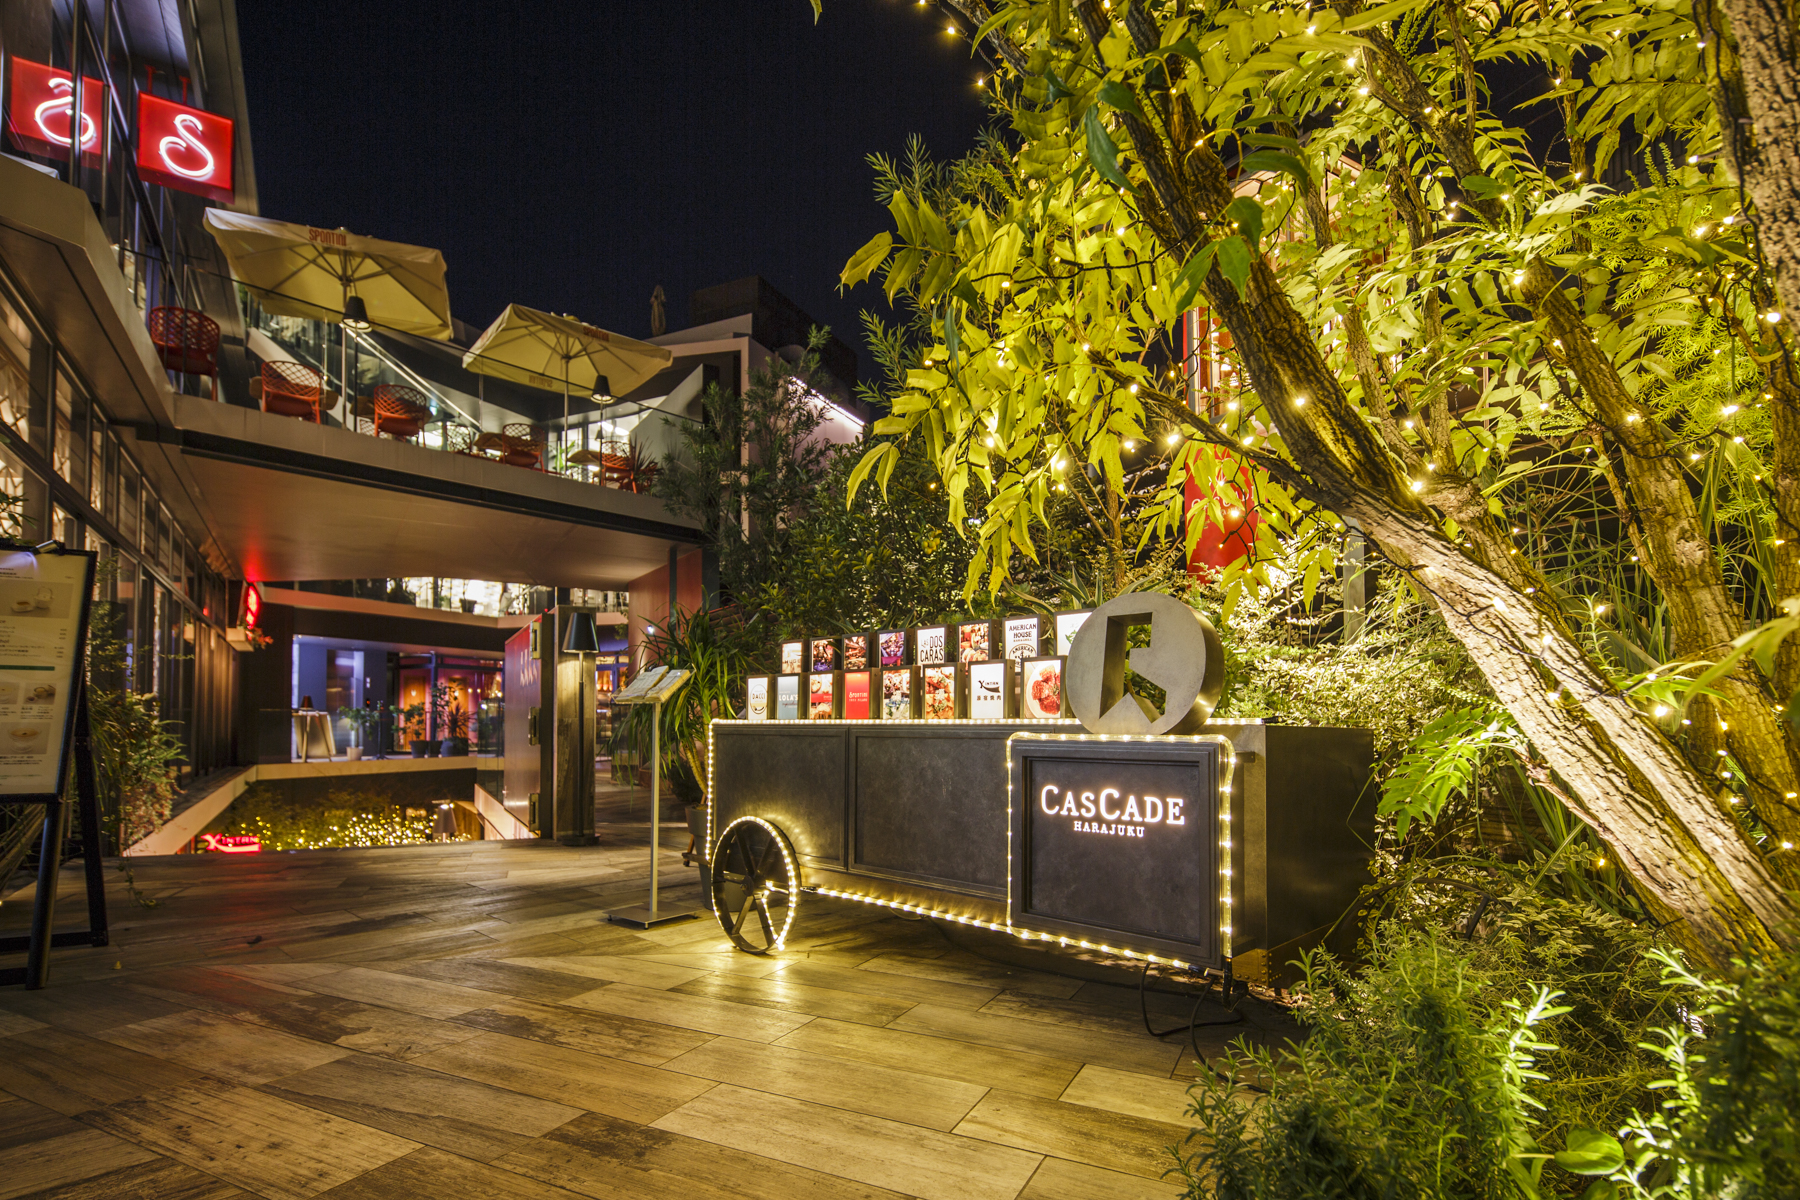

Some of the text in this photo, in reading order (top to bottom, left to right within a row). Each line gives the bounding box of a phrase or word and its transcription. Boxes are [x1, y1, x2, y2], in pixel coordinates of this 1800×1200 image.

[1008, 623, 1037, 632] AMERICAN
[929, 635, 944, 648] DOS
[1013, 631, 1033, 639] HOUSE
[919, 648, 944, 663] CARAS
[1073, 820, 1145, 838] HARAJUKU
